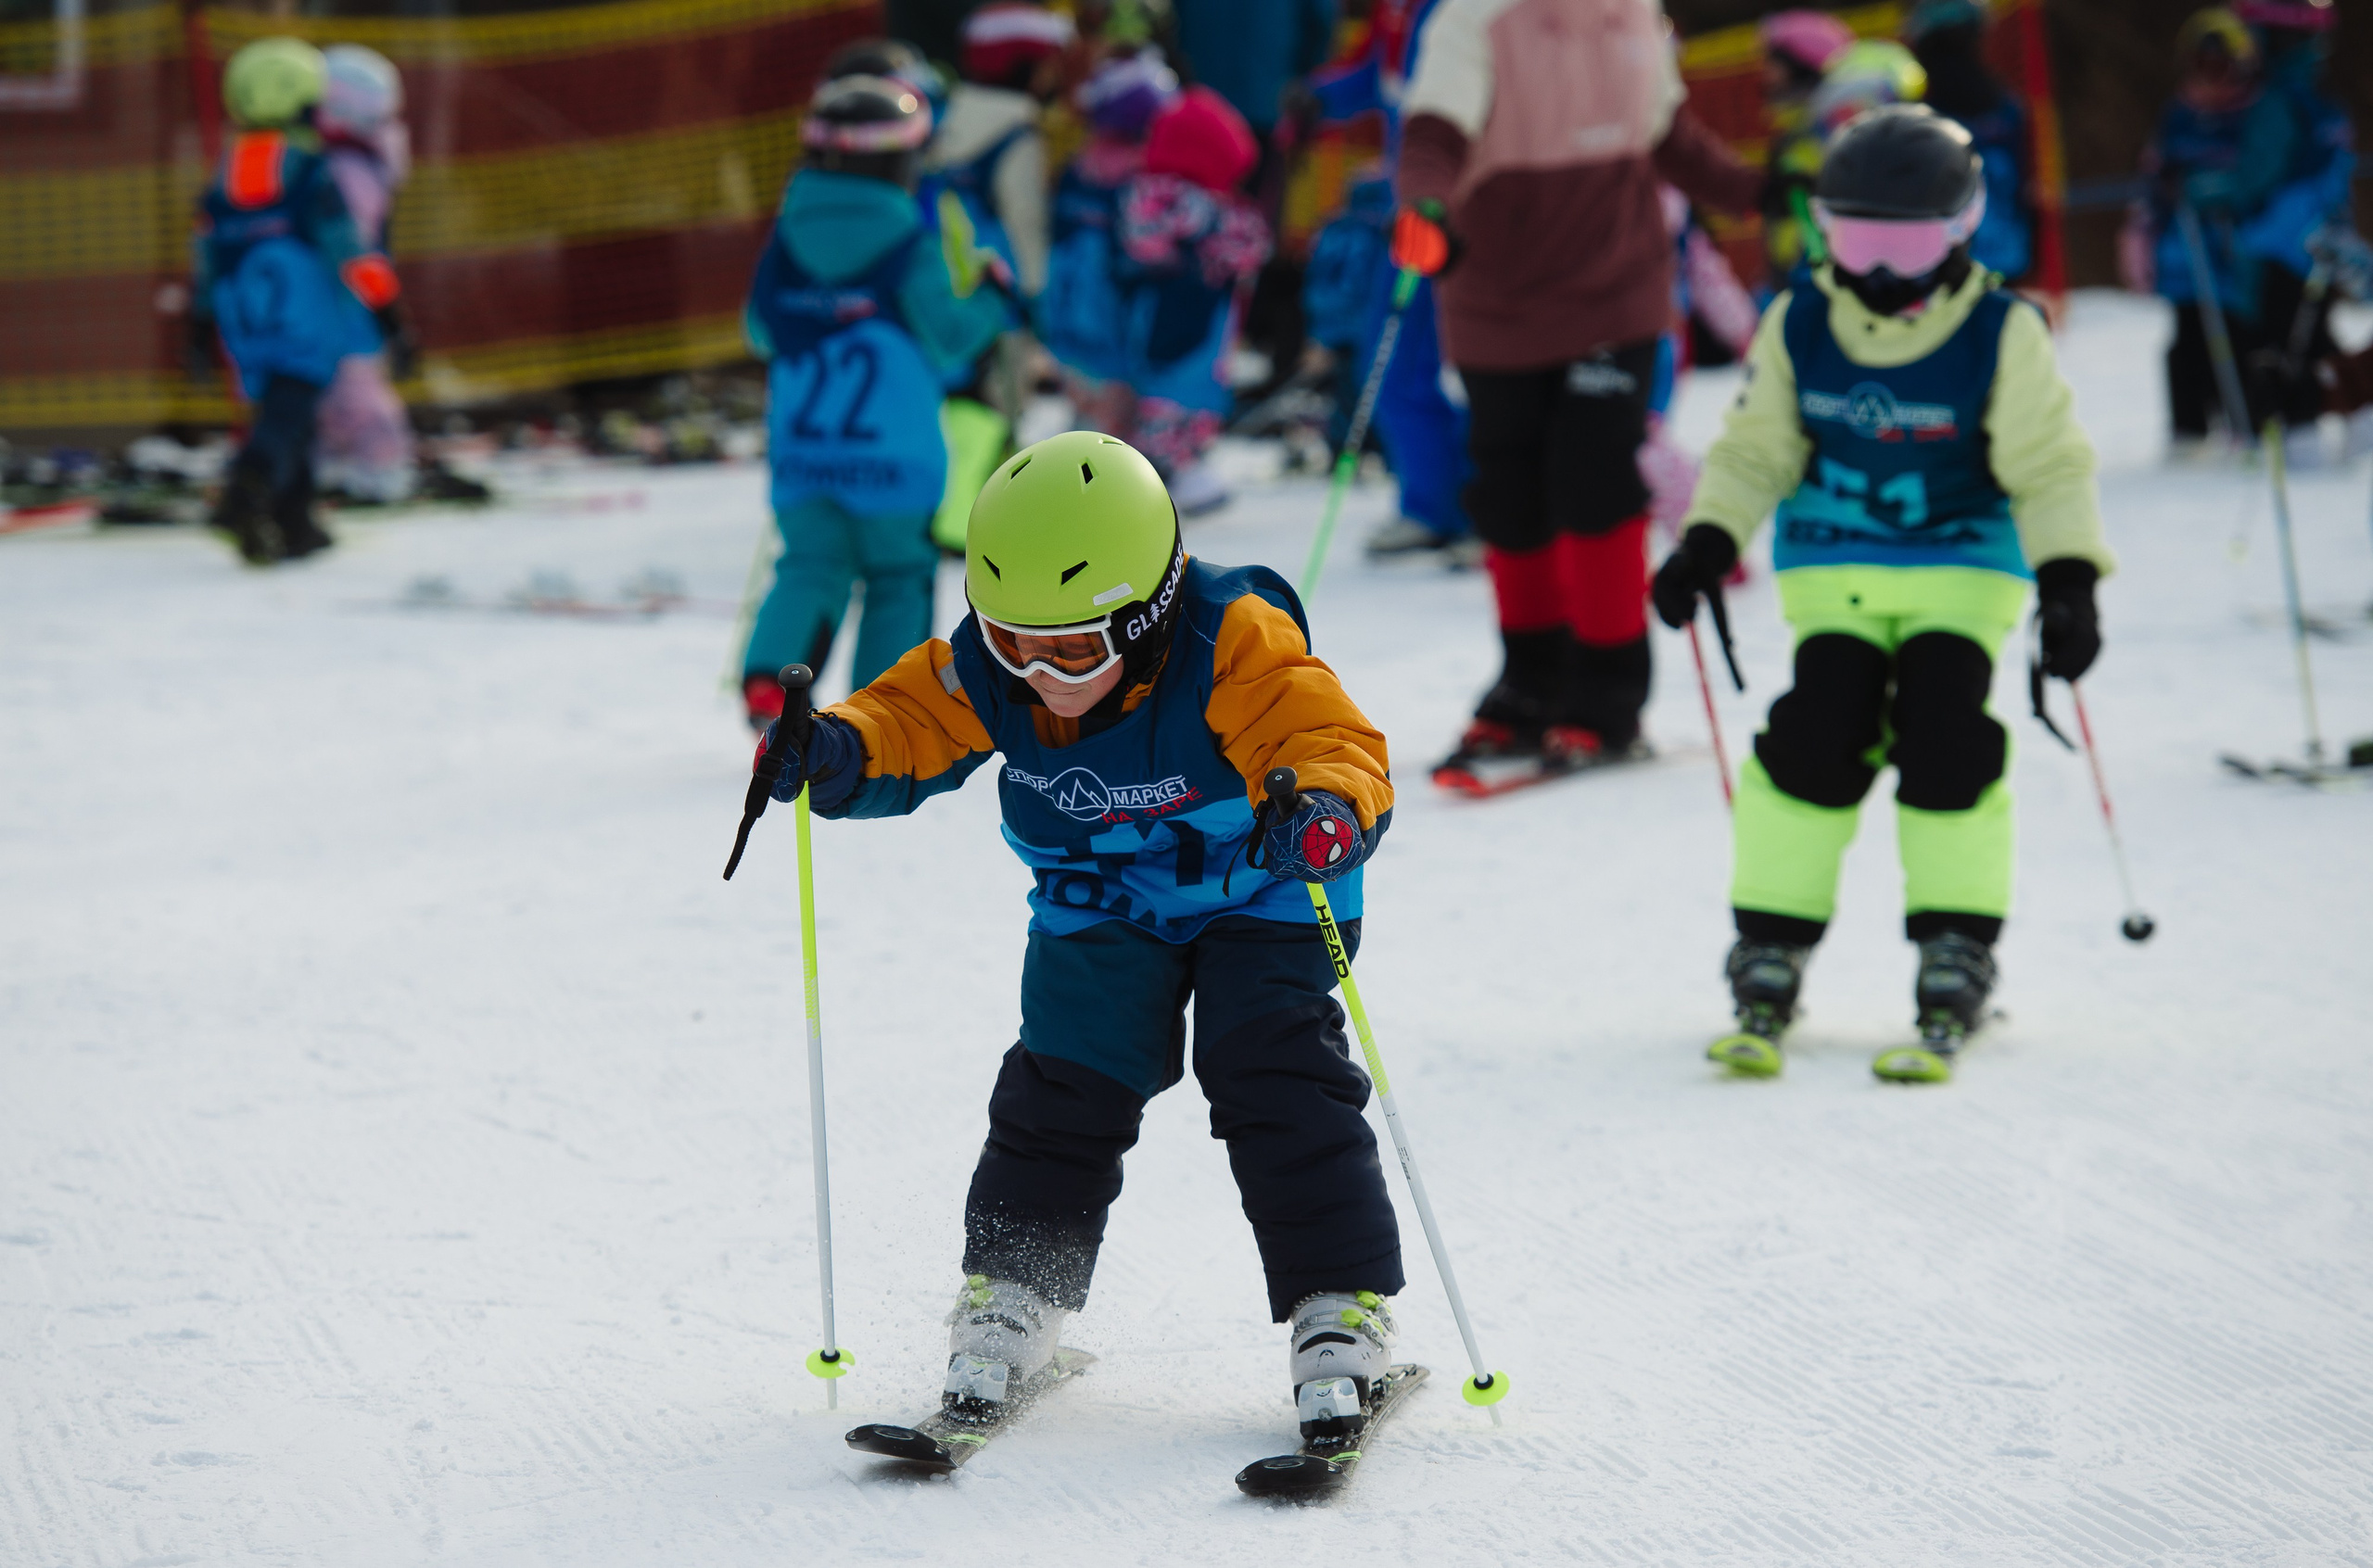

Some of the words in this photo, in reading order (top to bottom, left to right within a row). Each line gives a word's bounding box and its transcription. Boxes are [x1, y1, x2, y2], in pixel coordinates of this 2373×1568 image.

[791, 339, 878, 440] 22
[1100, 811, 1135, 824] НА
[1143, 786, 1203, 817] ЗАРЕ
[1112, 777, 1188, 805] МАРКЕТ
[1314, 904, 1350, 979] HEAD
